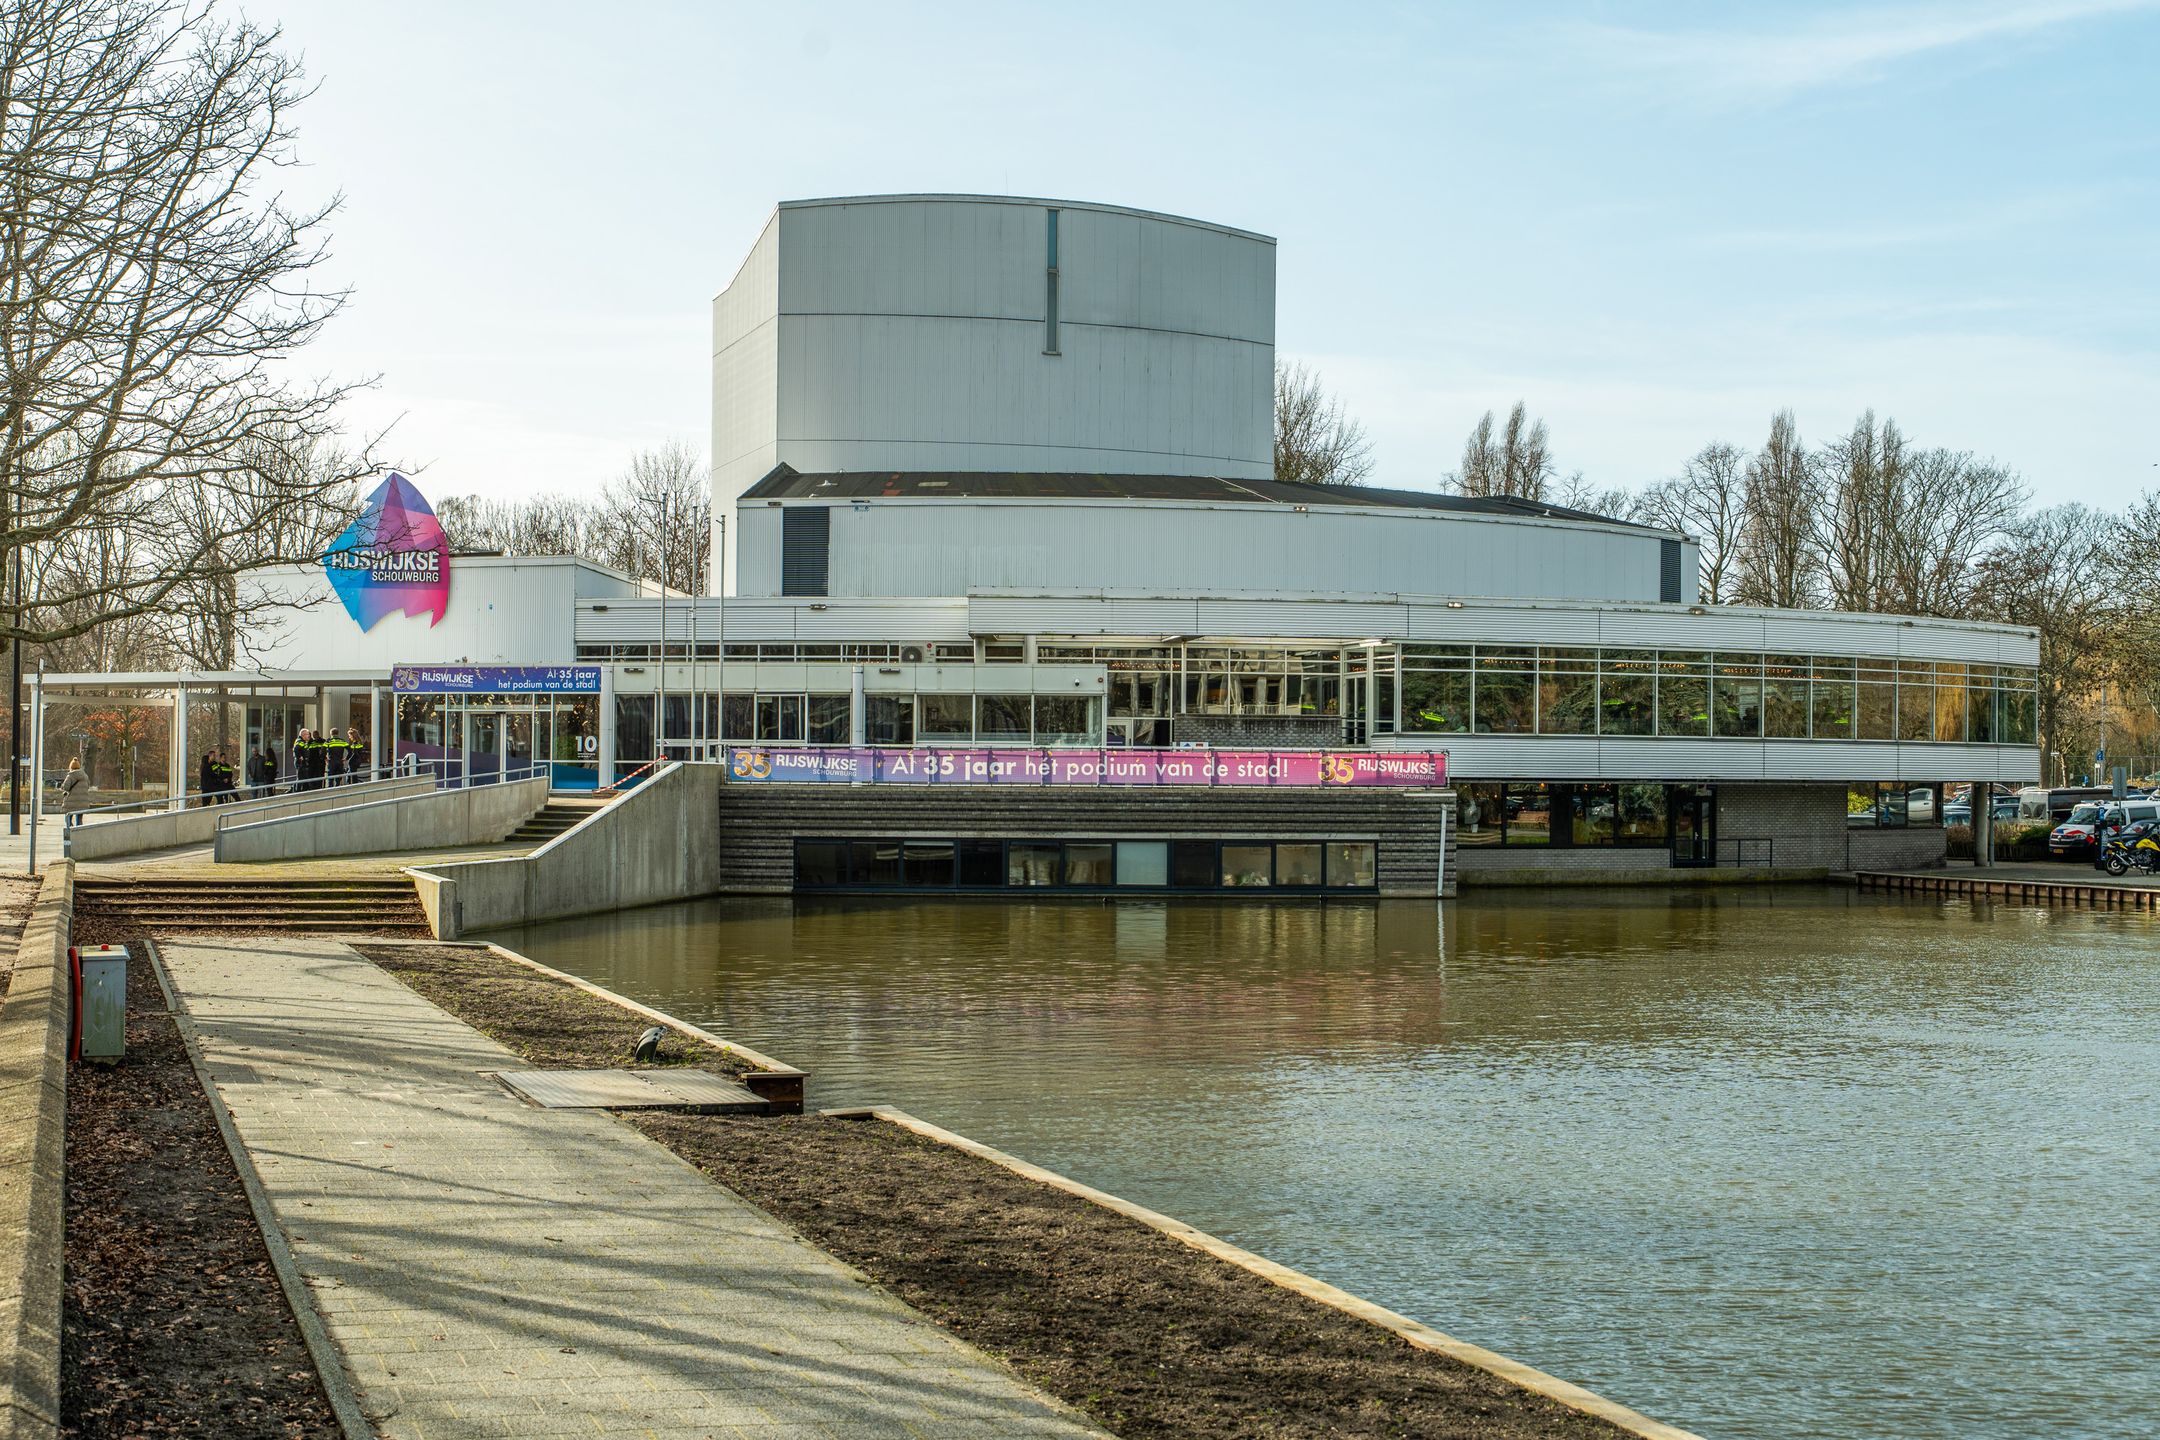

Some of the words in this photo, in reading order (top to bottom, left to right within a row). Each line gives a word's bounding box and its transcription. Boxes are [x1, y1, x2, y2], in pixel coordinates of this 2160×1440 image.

[332, 550, 439, 571] RIJSWIJKSE
[371, 571, 439, 582] SCHOUWBURG
[395, 670, 420, 690] 35
[422, 671, 474, 684] RIJSWIJKSE
[546, 669, 557, 679] Al
[559, 669, 572, 679] 35
[575, 669, 597, 681] jaar
[498, 679, 511, 689] het
[512, 679, 543, 691] podium
[545, 681, 560, 689] van
[562, 679, 573, 689] de
[575, 679, 596, 689] stad!
[575, 735, 598, 753] 10
[733, 751, 772, 778] 35
[776, 754, 858, 771] RIJSWIJKSE
[891, 755, 915, 774] Al
[923, 755, 954, 775] 35
[965, 755, 1016, 781] jaar
[1025, 755, 1058, 775] het
[1066, 756, 1146, 781] podium
[1155, 762, 1193, 777] van
[1202, 757, 1229, 777] de
[1237, 757, 1289, 778] stad!
[1317, 755, 1354, 783] 35
[1358, 758, 1436, 775] RIJSWIJKSE
[812, 768, 857, 777] SCHOUWBURG
[1393, 772, 1436, 781] SCHOUWBURG
